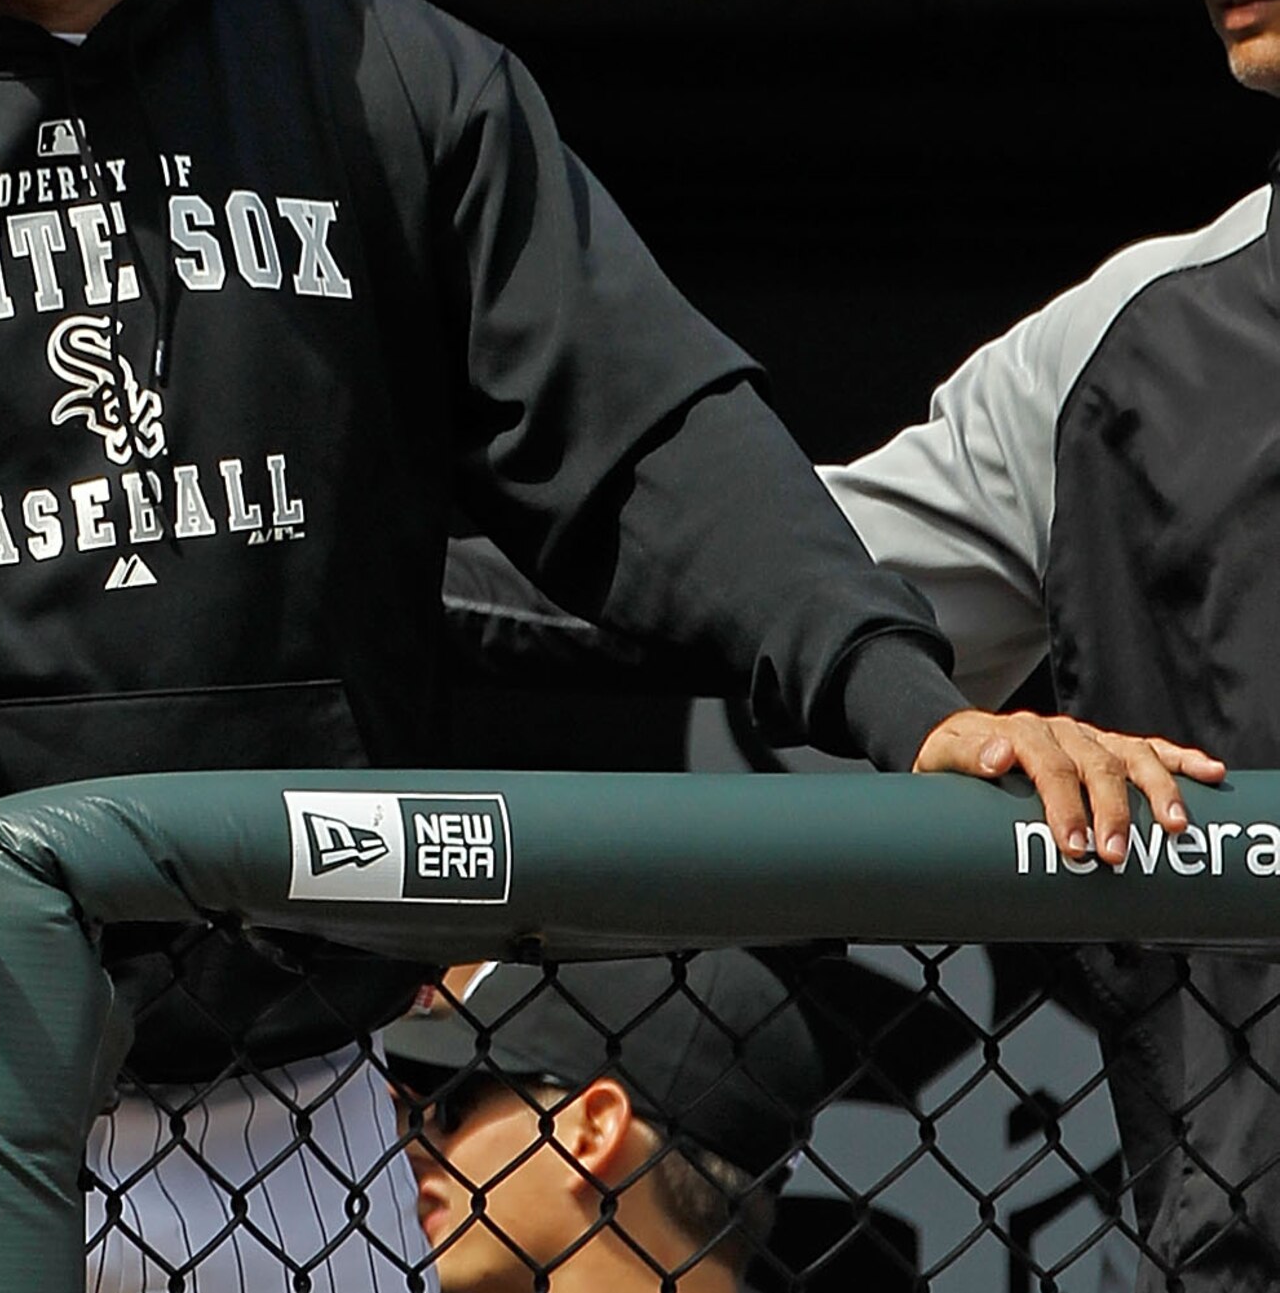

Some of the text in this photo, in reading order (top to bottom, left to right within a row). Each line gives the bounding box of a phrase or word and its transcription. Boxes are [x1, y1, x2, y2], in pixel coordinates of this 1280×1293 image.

[169, 189, 353, 300] SOX
[413, 812, 494, 845] NEW
[417, 845, 494, 879] ERA
